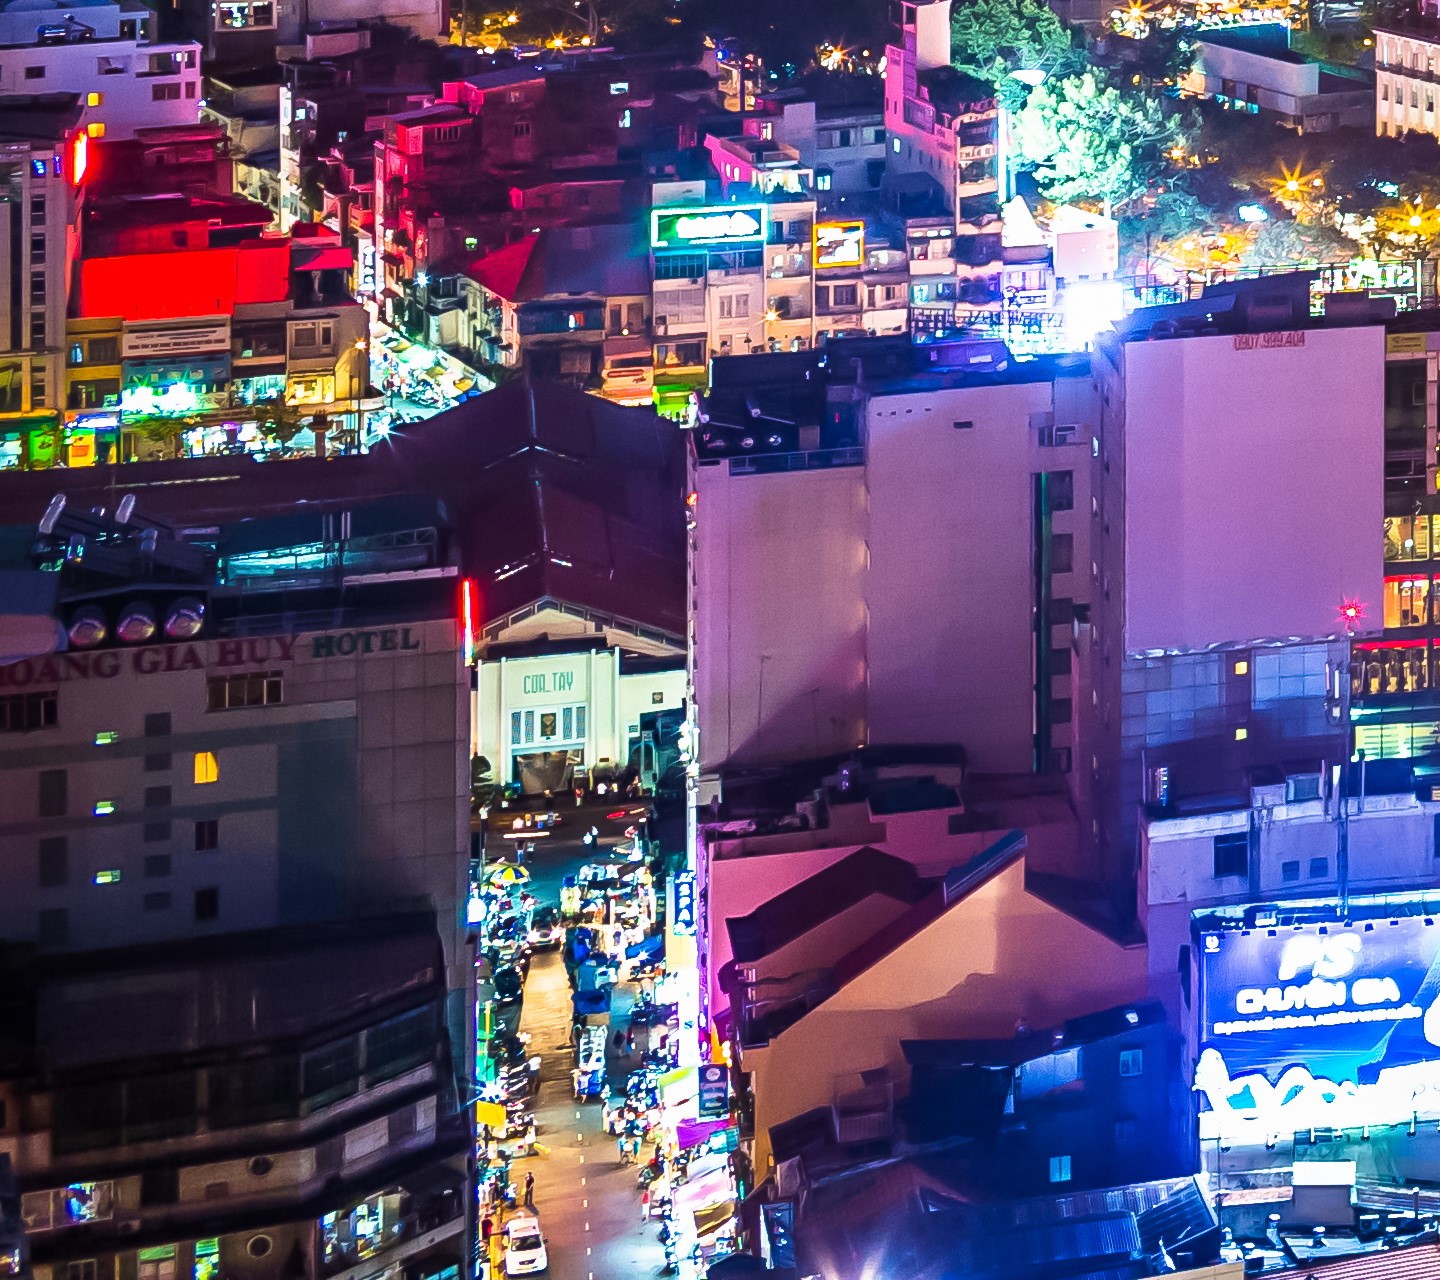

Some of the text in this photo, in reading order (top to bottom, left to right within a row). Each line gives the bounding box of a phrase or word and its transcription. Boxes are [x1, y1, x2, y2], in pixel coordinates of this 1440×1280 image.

[0, 627, 420, 687] OANG GIA HUY HOTEL
